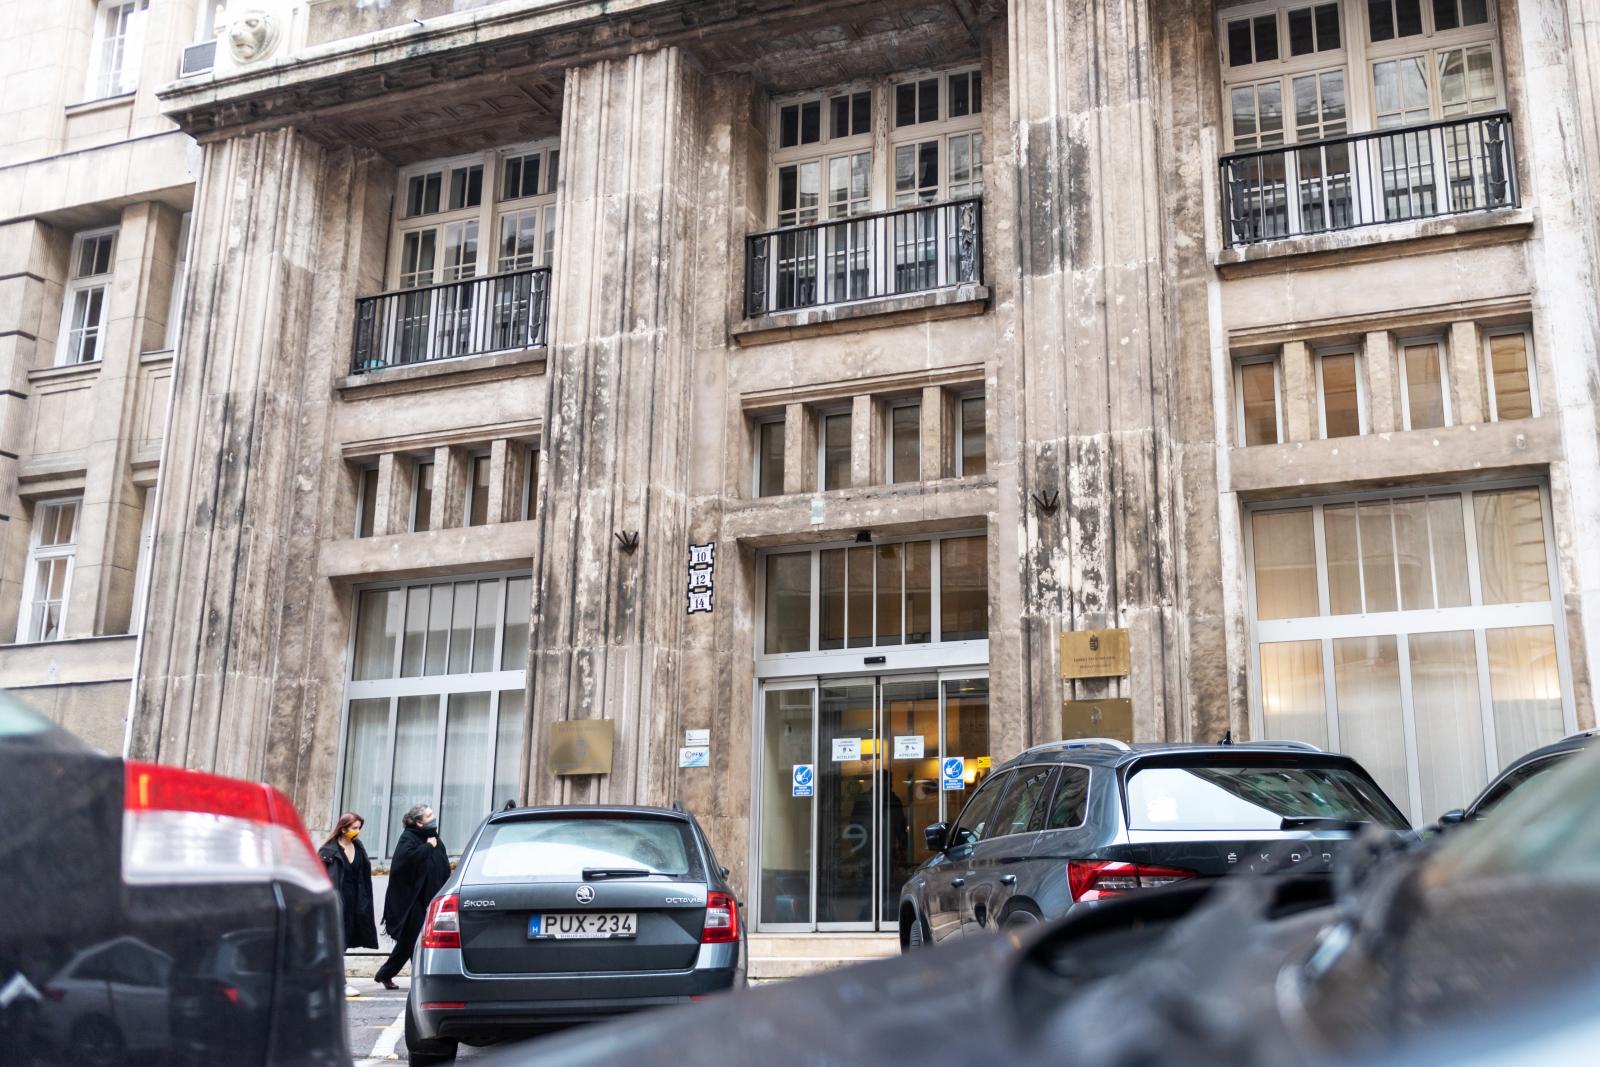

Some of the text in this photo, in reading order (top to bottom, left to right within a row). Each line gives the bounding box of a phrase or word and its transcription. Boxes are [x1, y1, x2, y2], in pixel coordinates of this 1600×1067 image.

[696, 551, 707, 562] 10
[696, 574, 706, 585] 12
[695, 598, 705, 609] 14
[1227, 852, 1332, 863] ŠKOD
[463, 899, 496, 908] ŠKODA
[545, 914, 632, 934] PUX-234
